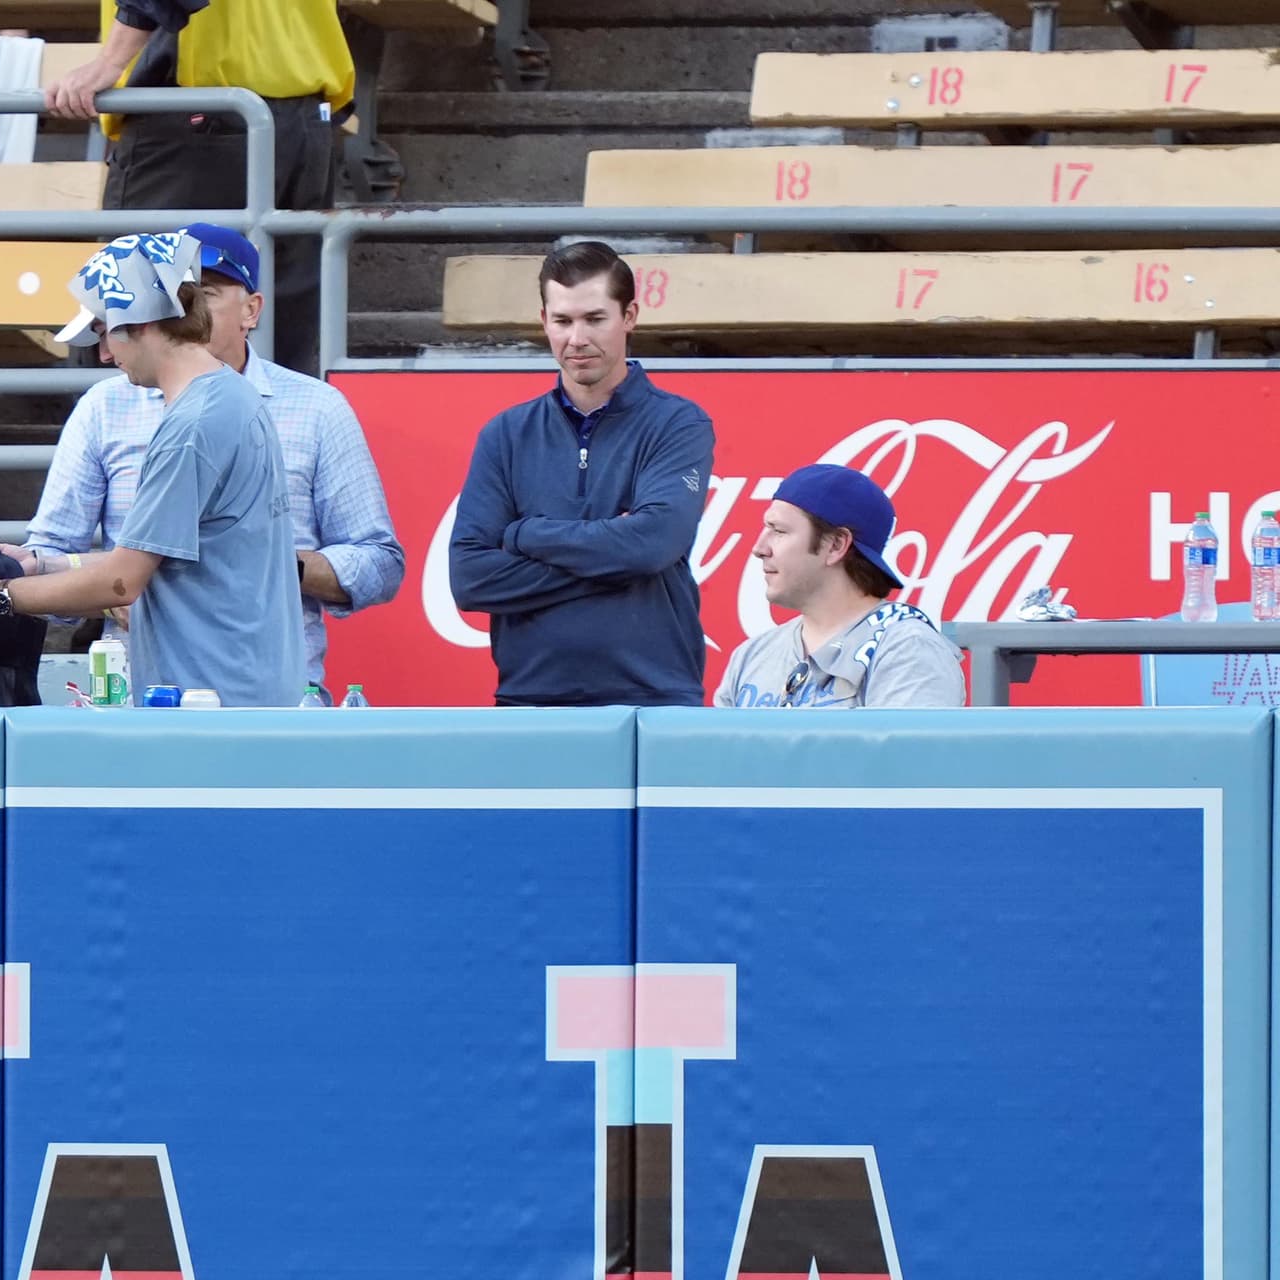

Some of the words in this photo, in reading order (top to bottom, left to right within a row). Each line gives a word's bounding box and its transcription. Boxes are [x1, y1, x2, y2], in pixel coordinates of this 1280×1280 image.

[928, 67, 965, 105] 18
[1164, 64, 1208, 104] 17
[775, 160, 811, 201] 18
[1051, 162, 1094, 203] 17
[896, 269, 939, 309] 17
[1134, 264, 1169, 303] 16
